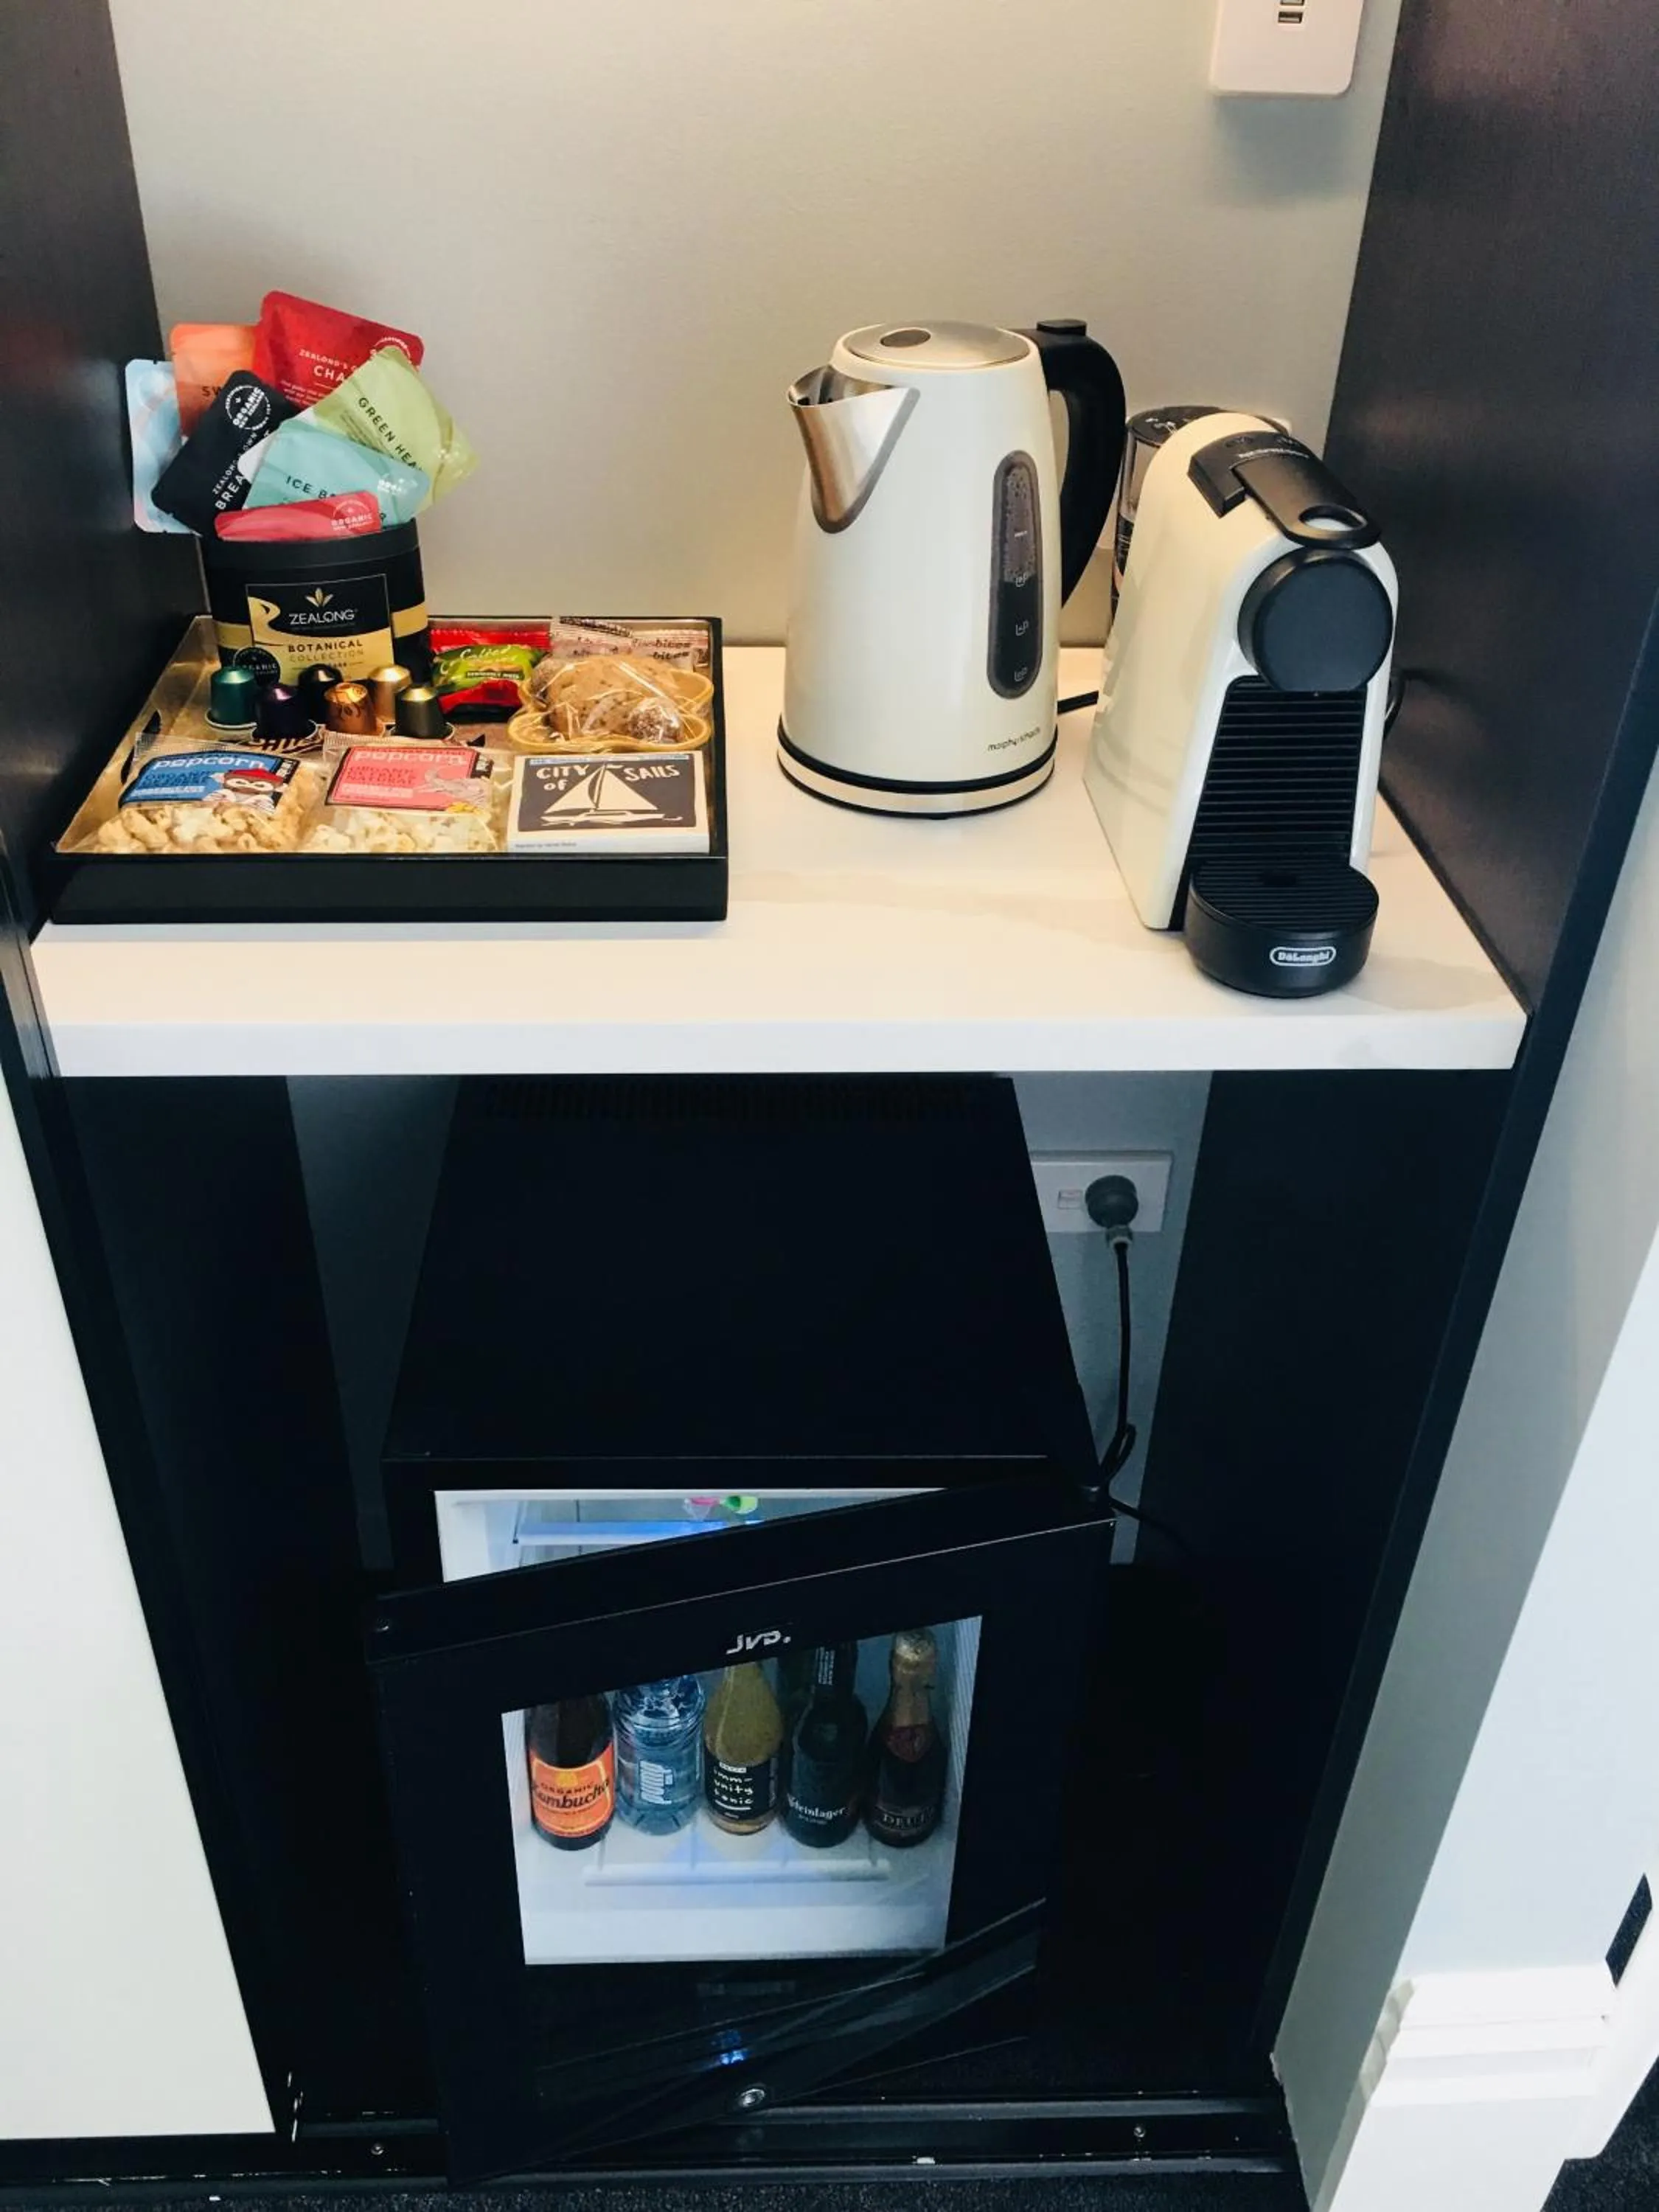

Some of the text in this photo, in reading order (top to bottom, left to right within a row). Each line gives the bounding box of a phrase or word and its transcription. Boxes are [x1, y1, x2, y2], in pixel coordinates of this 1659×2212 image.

[358, 397, 396, 442] GREEN
[285, 475, 313, 493] ICE
[288, 609, 355, 625] ZEALONG
[288, 639, 364, 653] BOTANICAL
[152, 756, 268, 770] popcorn
[354, 751, 468, 765] popcorn
[536, 764, 590, 780] CITY
[623, 764, 681, 782] SAILS
